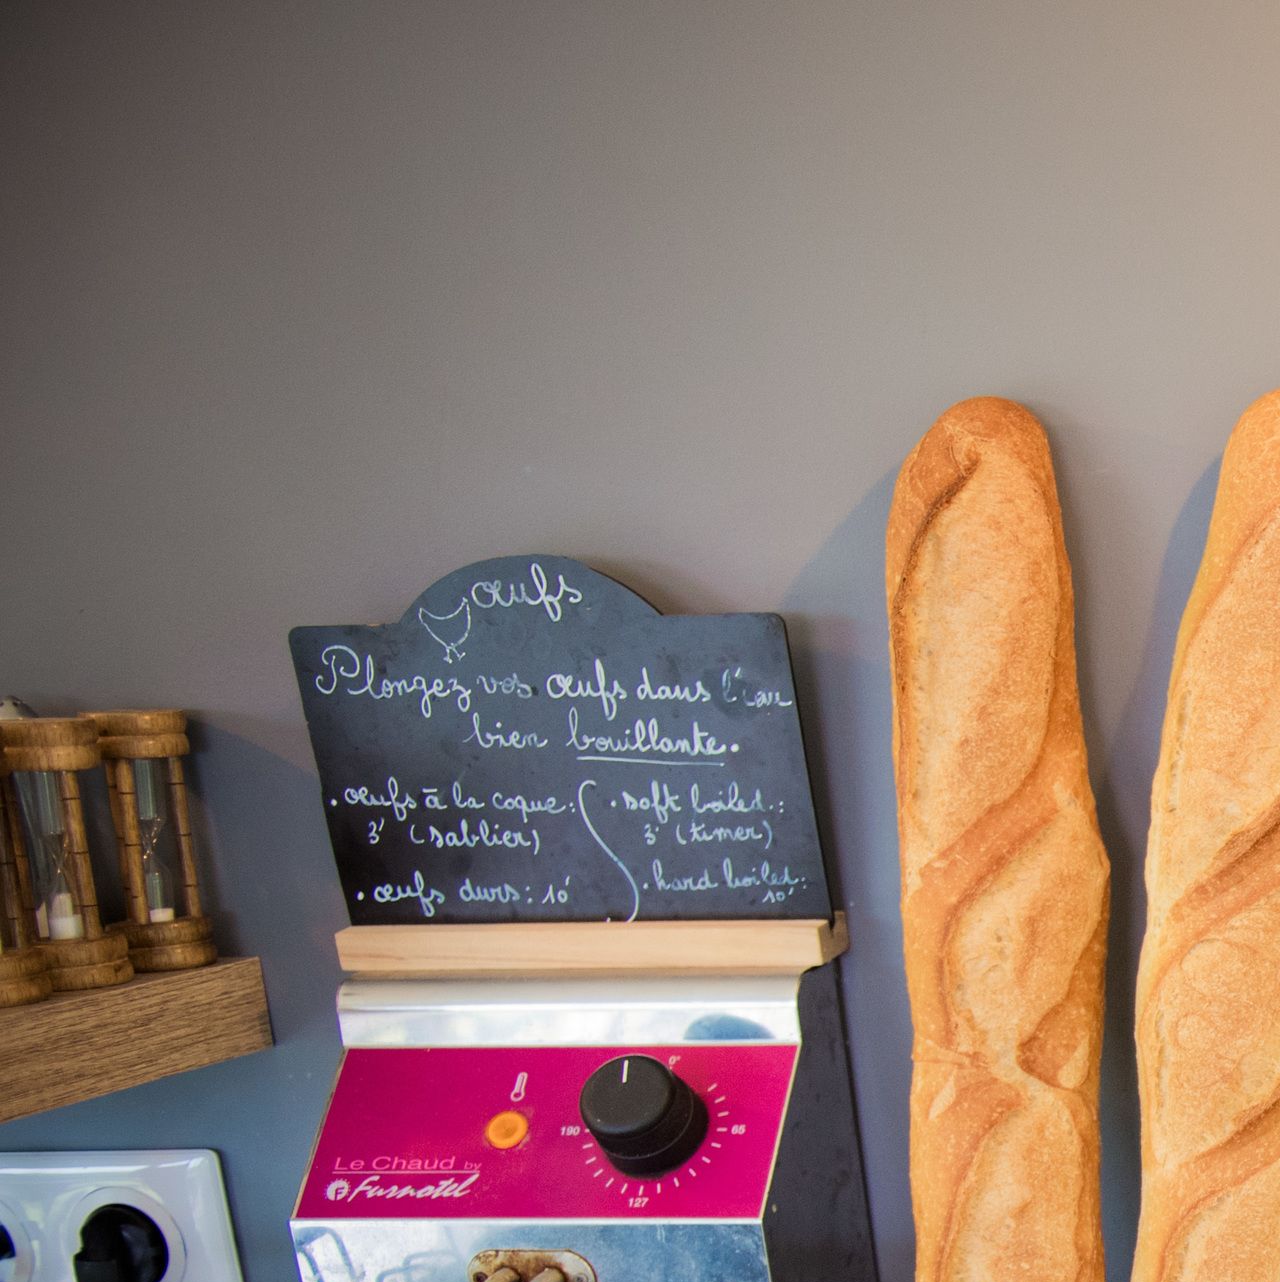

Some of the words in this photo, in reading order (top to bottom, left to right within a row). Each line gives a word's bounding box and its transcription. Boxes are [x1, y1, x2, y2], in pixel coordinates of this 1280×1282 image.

[315, 644, 472, 719] Plongez
[476, 672, 534, 699] vos
[462, 711, 549, 749] bien
[452, 781, 485, 809] la
[621, 779, 683, 825] soft
[409, 818, 541, 856] (sablier)
[675, 818, 774, 851] (timer)
[651, 857, 719, 892] hard
[334, 1156, 365, 1171] Le
[371, 1155, 456, 1171] Chaud
[463, 1160, 483, 1173] by
[628, 1197, 650, 1208] 127
